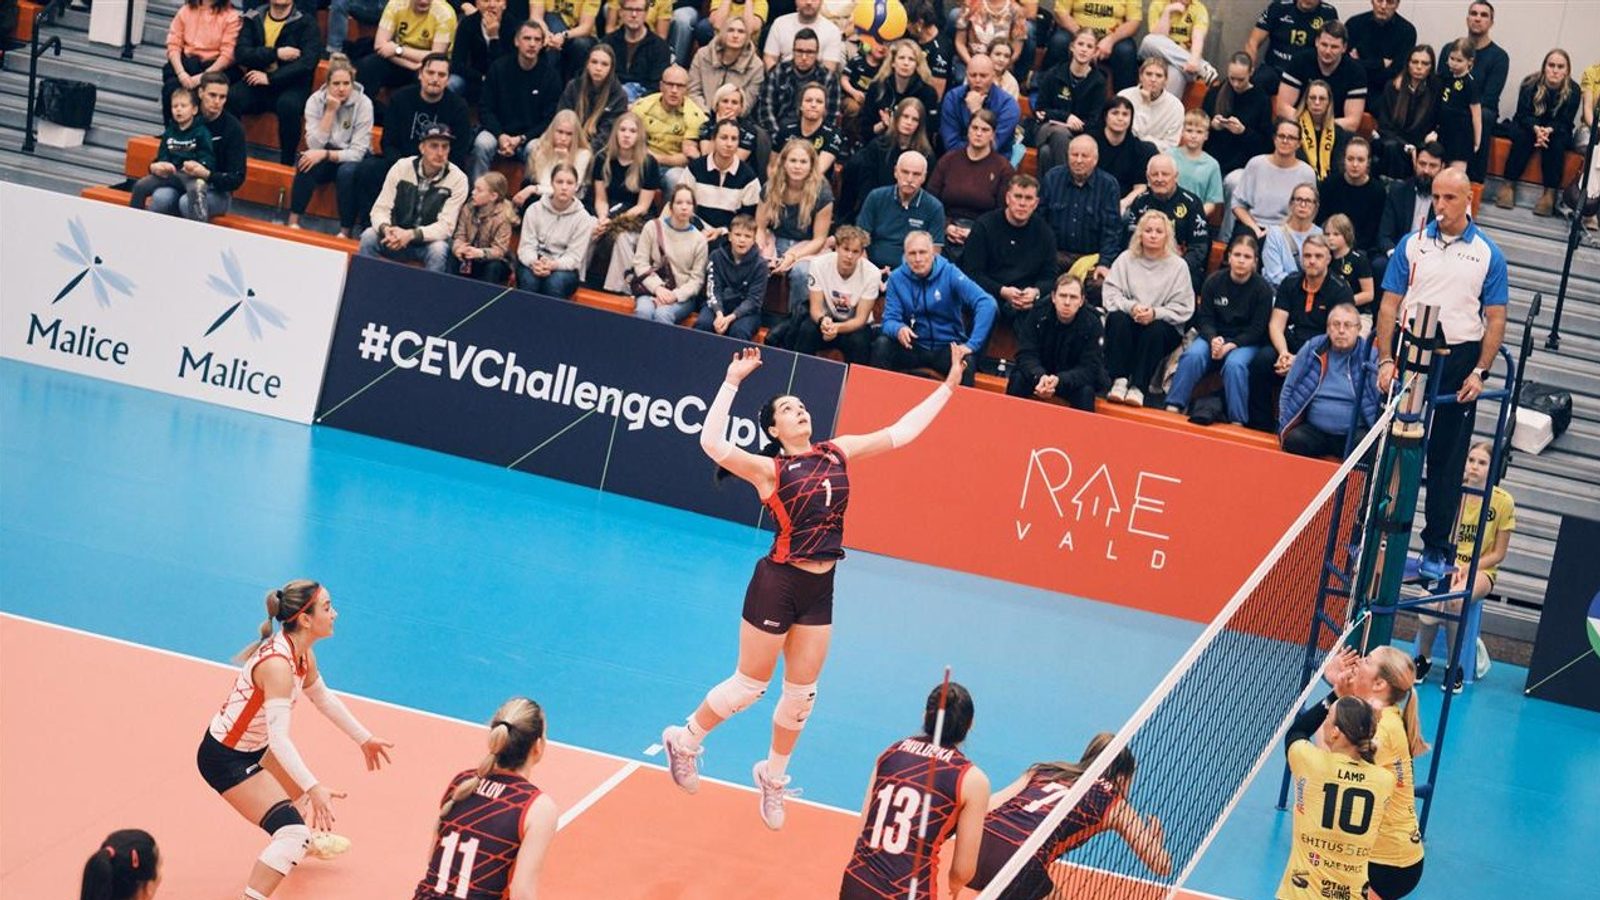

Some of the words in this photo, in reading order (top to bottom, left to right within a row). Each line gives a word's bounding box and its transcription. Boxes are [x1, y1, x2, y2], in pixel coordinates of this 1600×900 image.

[1290, 29, 1307, 46] 13
[26, 313, 129, 365] Malice
[178, 346, 281, 398] Malice
[358, 322, 772, 451] #CEVChallengeCp
[821, 479, 832, 507] 1
[1020, 447, 1182, 540] RAE
[1016, 520, 1166, 569] VALD
[898, 739, 955, 762] PAVLOKA
[1337, 769, 1366, 783] LAMP
[870, 784, 921, 855] 13
[1321, 782, 1375, 836] 10
[434, 831, 480, 899] 11
